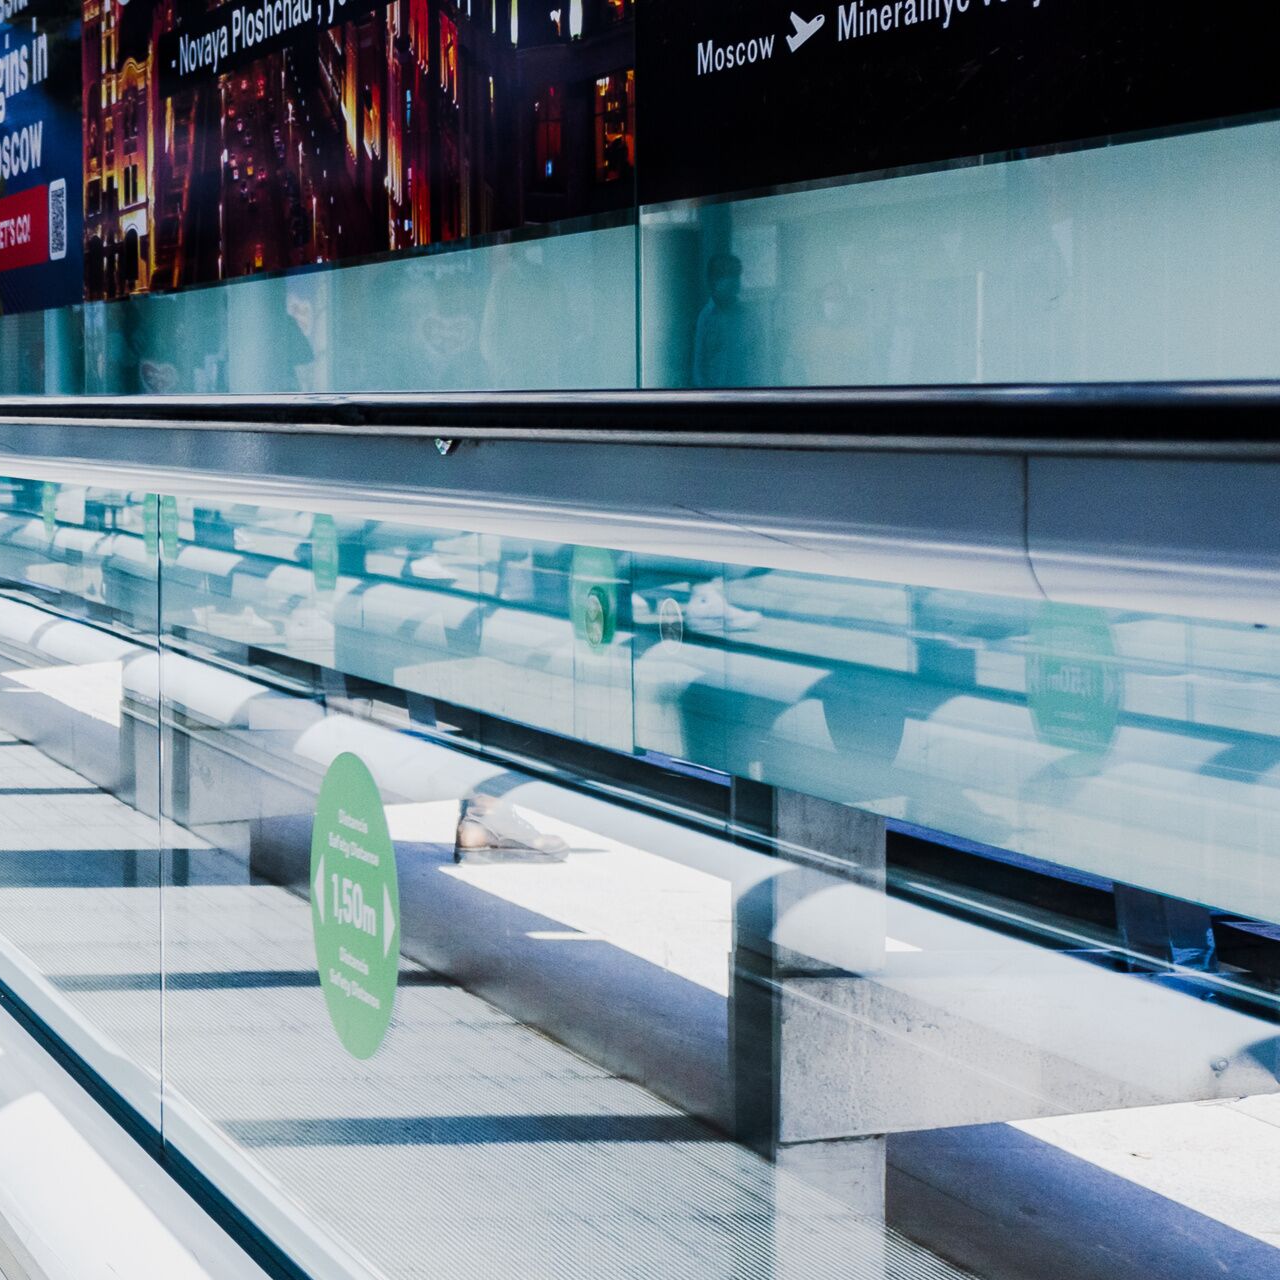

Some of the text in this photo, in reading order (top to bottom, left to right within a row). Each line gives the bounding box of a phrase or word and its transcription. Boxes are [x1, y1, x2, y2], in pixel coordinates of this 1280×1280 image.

[32, 16, 48, 84] in
[179, 33, 228, 76] Novaya
[697, 35, 775, 76] Moscow
[16, 213, 31, 244] GO!
[331, 873, 377, 937] 1,50m
